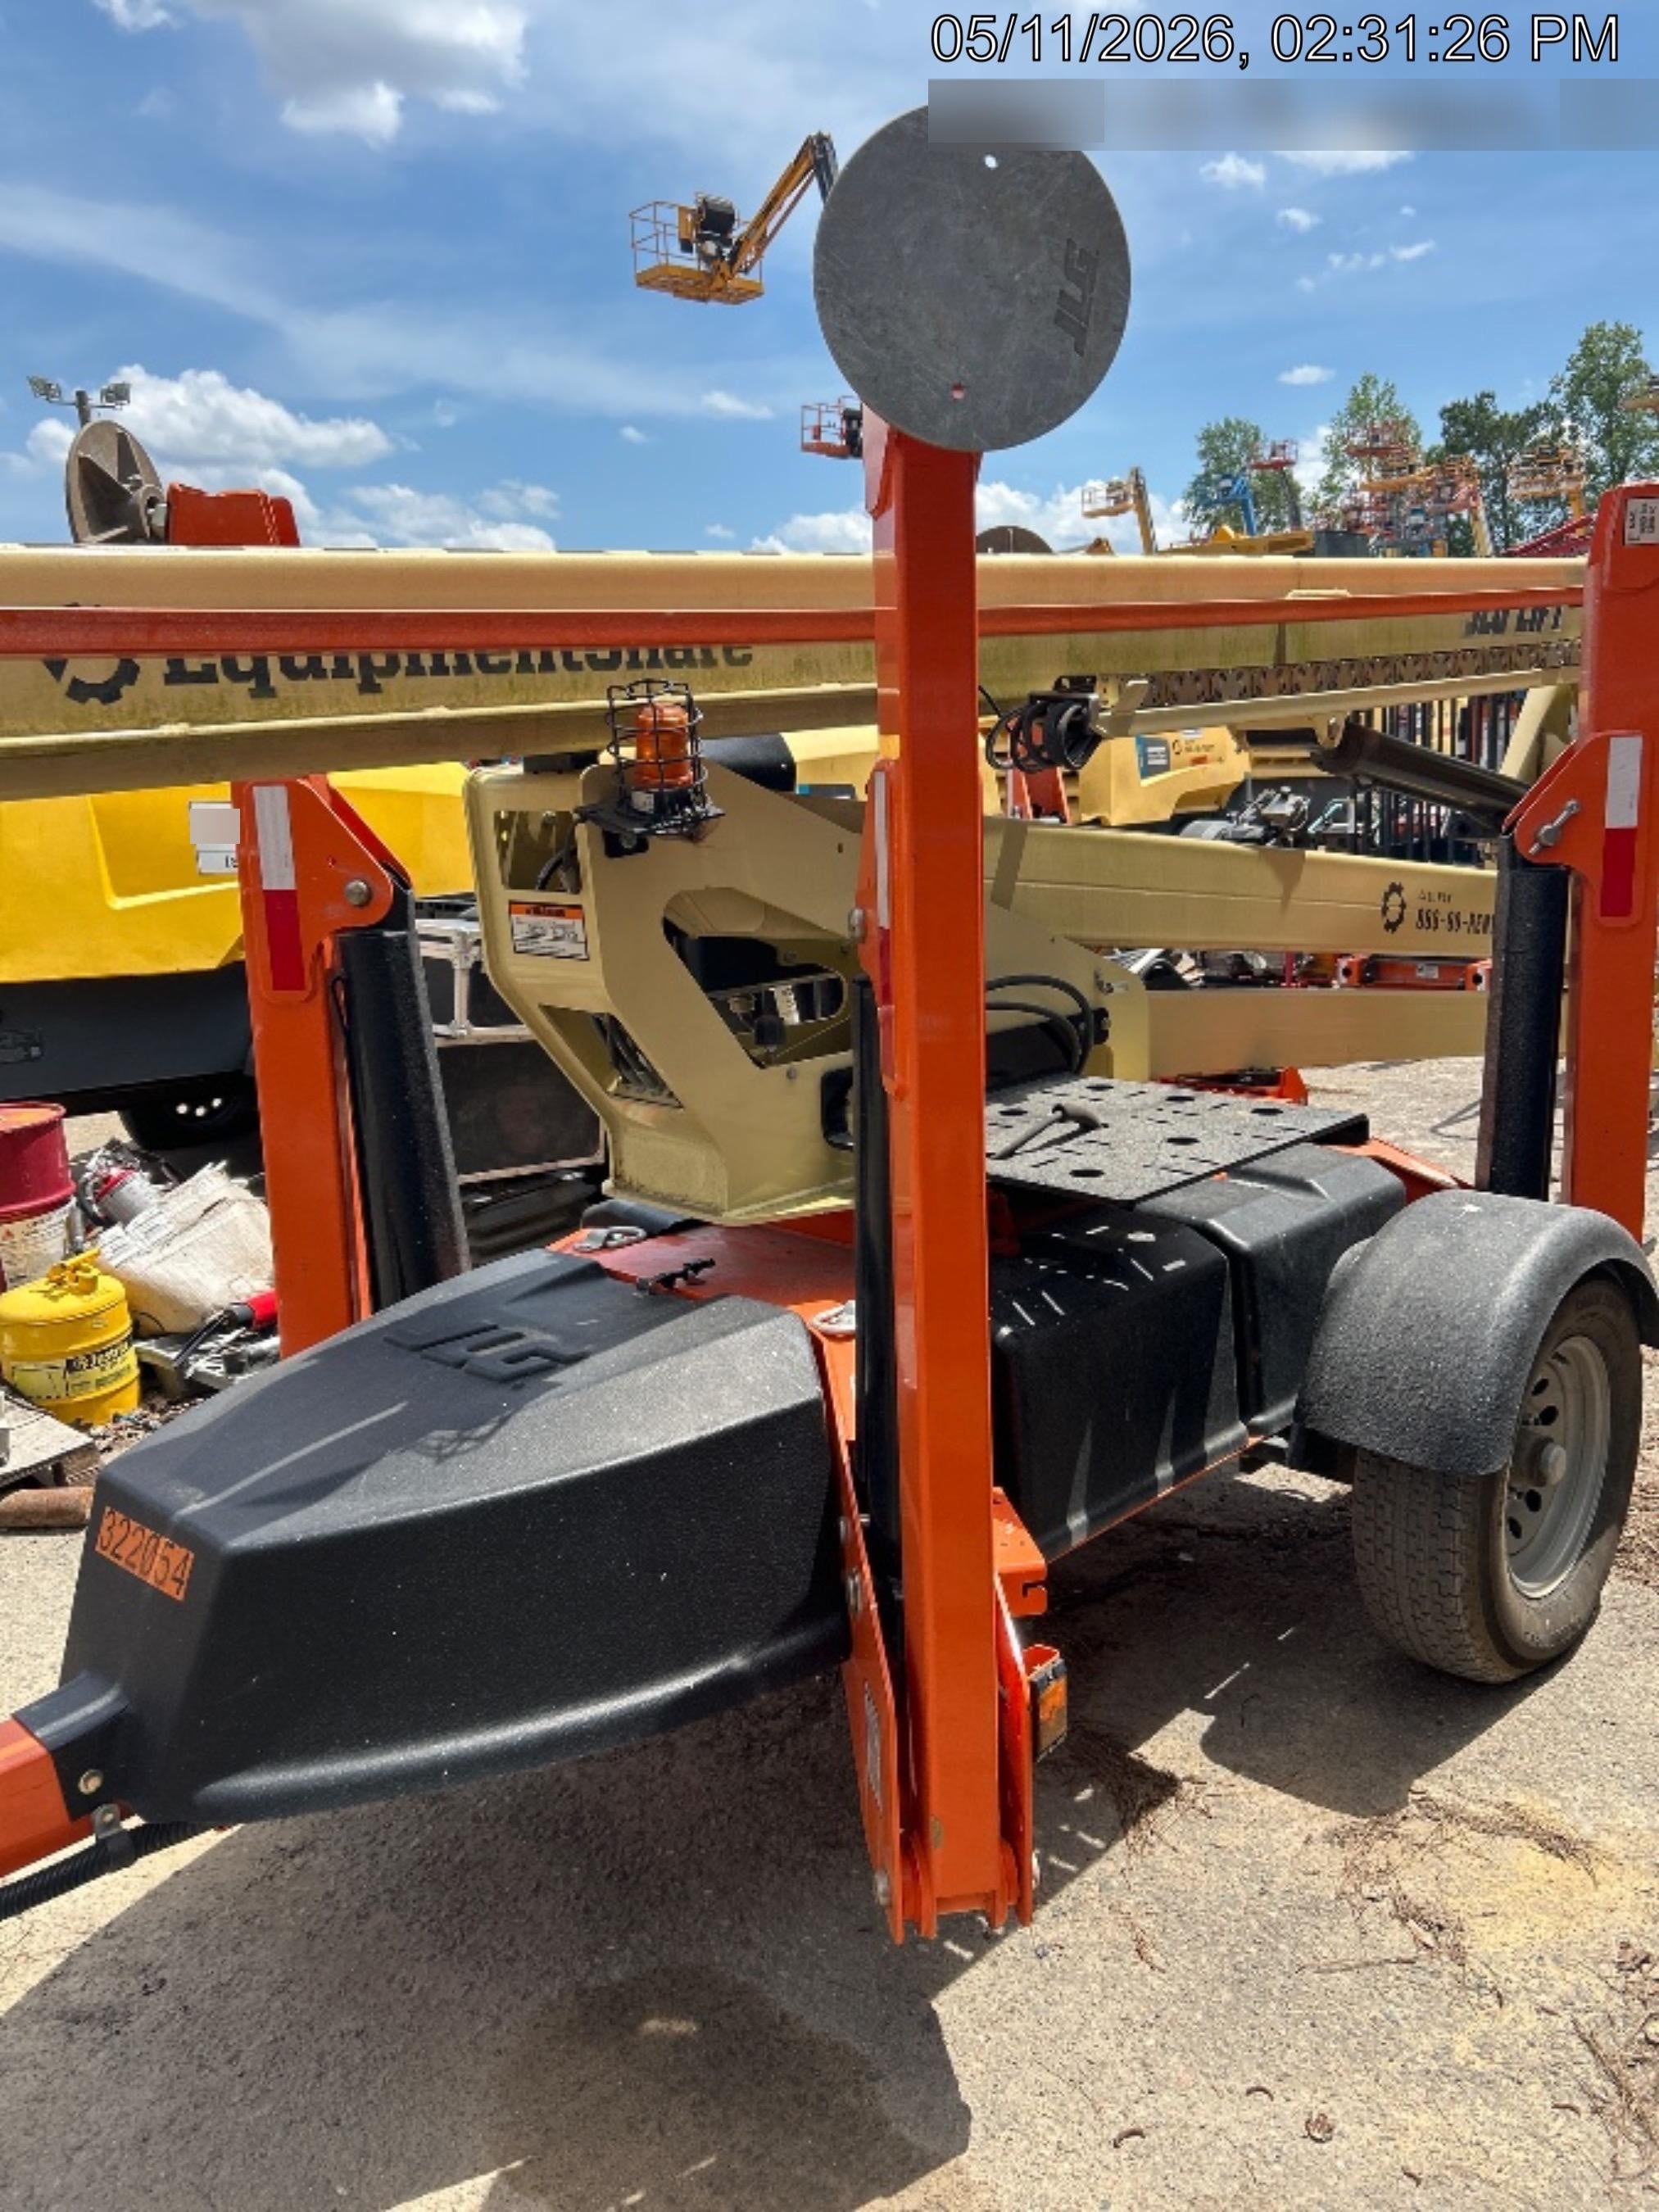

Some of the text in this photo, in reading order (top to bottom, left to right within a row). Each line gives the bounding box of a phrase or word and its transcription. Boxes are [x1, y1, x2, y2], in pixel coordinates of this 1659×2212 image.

[1054, 238, 1099, 357] JLG
[382, 1321, 590, 1384] JLG
[100, 1510, 190, 1596] 322054
